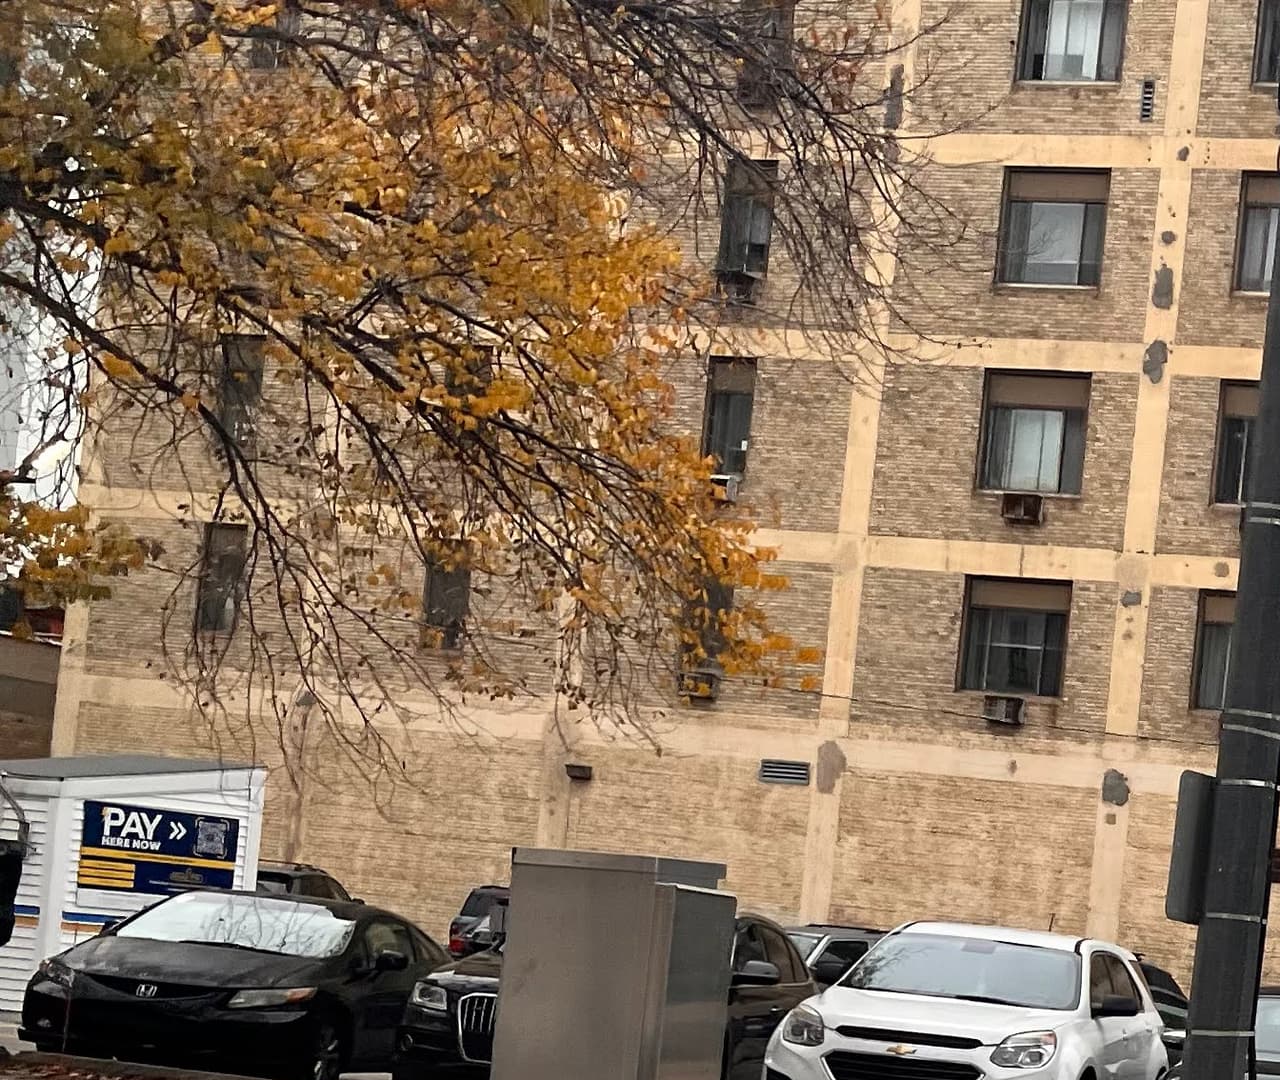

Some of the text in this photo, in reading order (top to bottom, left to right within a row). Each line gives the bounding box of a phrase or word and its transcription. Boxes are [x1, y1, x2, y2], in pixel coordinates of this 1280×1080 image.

[102, 806, 163, 841] PAY
[101, 836, 161, 850] HERE NOW
